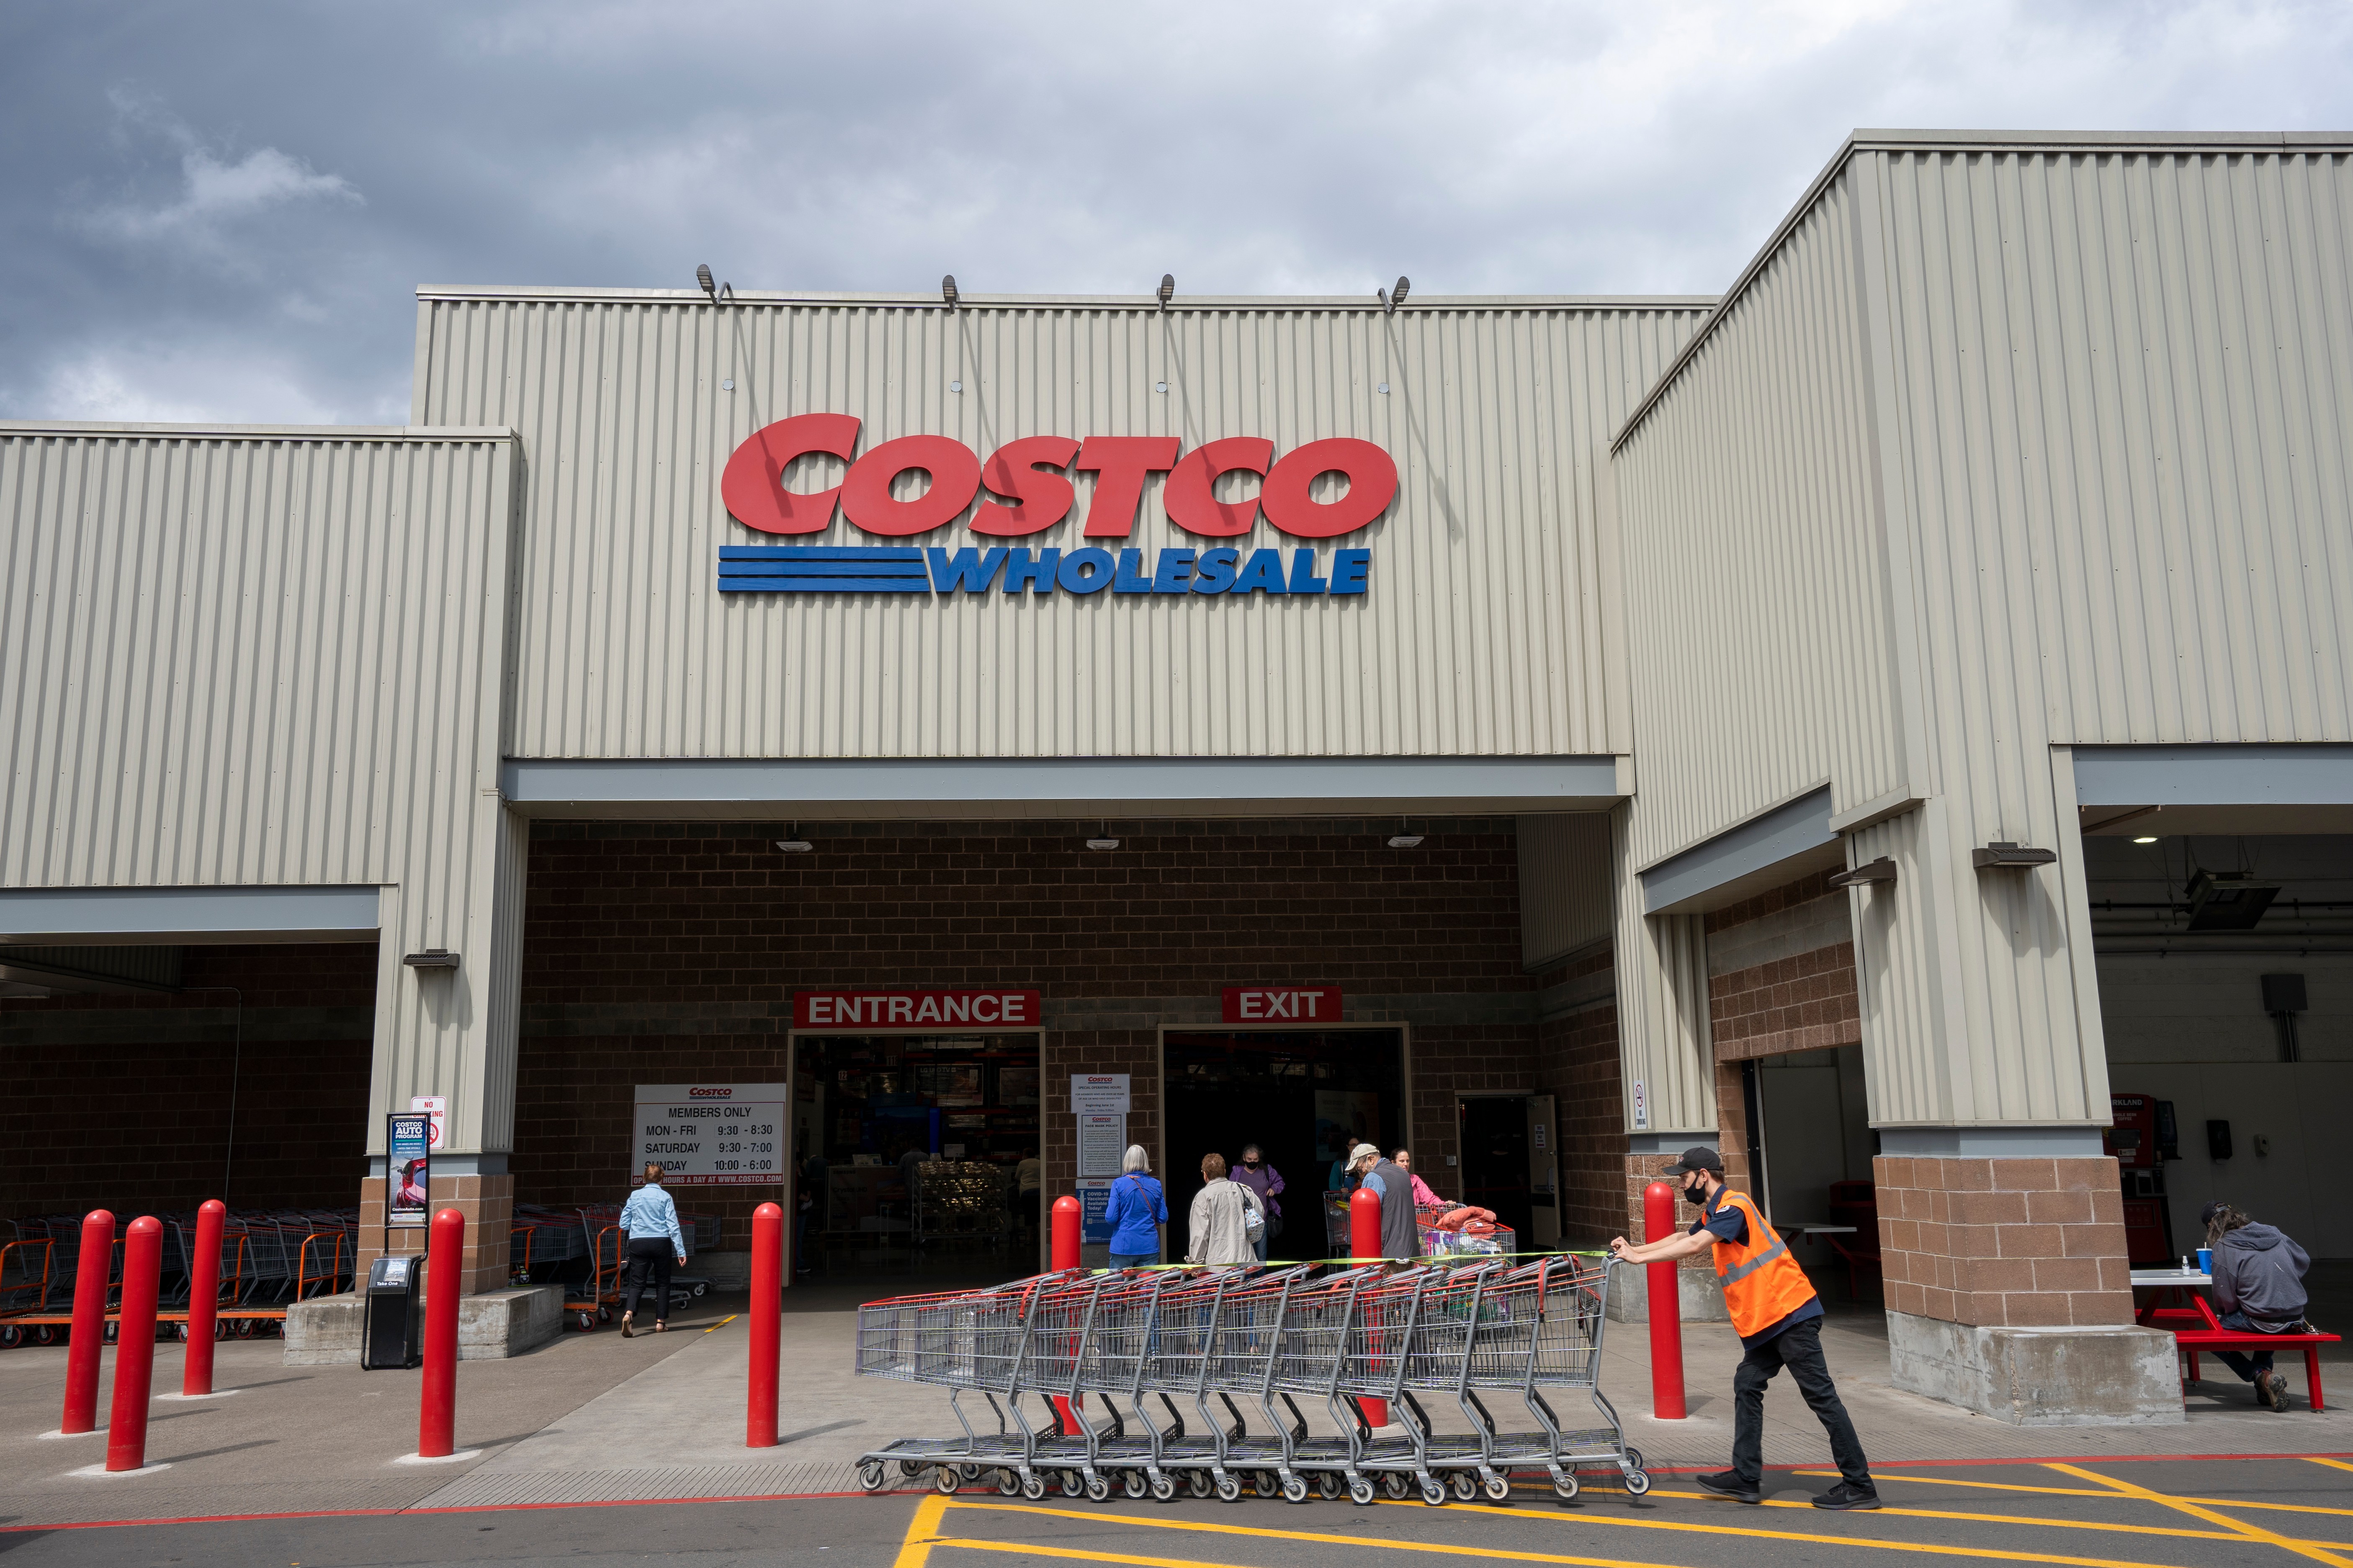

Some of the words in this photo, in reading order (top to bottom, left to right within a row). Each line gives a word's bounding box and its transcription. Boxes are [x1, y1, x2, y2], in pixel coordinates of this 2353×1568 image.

[721, 413, 1397, 537] COSTCO
[927, 547, 1370, 594] WHOLESALE
[809, 995, 1025, 1023] ENTRANCE
[1240, 992, 1323, 1018] EXIT
[669, 1108, 721, 1118] MEMBERS
[724, 1107, 751, 1117] ONLY
[646, 1126, 670, 1136] MON
[680, 1125, 696, 1135] FRI
[718, 1126, 738, 1135] 9:30
[751, 1125, 772, 1134] 8:30
[646, 1143, 700, 1153] SATURDAY
[719, 1143, 741, 1152] 9:30
[750, 1143, 772, 1152] 7:00
[714, 1160, 739, 1170] 10:00
[749, 1160, 771, 1170] 6:00
